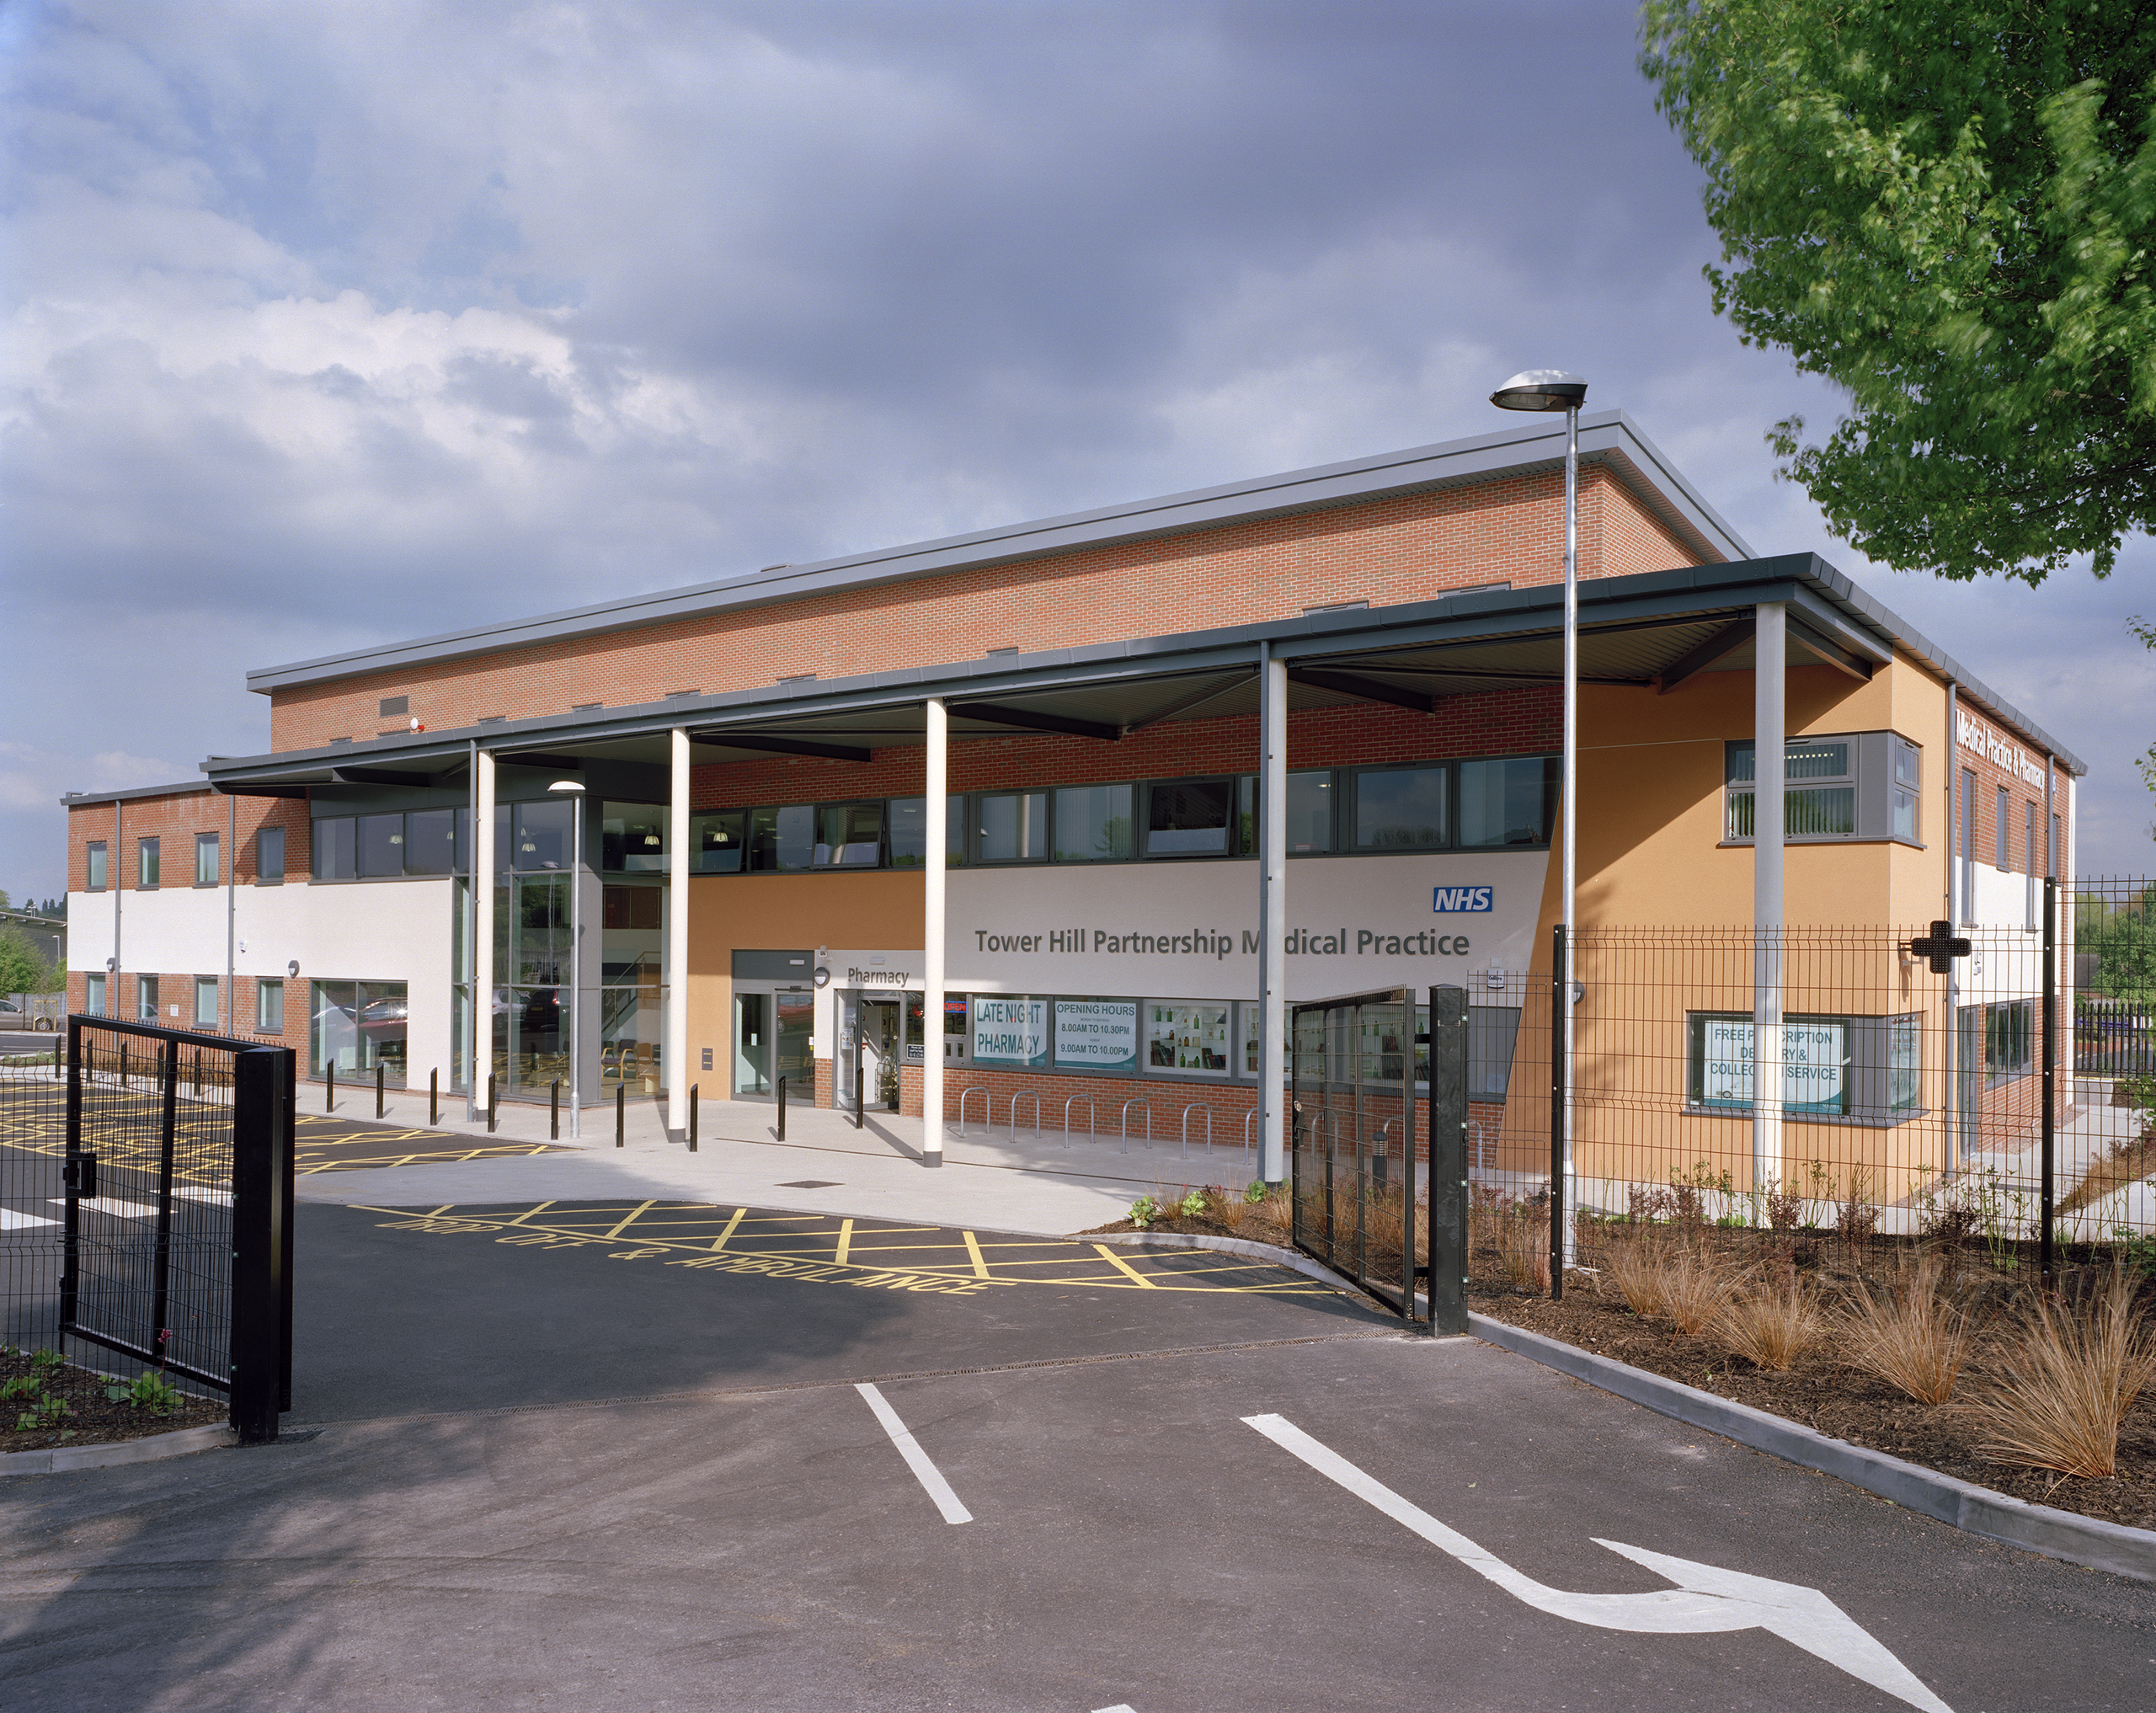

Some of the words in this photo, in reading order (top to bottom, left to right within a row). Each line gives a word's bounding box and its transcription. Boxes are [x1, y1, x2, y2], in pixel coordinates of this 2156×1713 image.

[1956, 708, 1986, 757] Medical
[1986, 728, 2013, 773] Practice
[2013, 746, 2019, 776] &
[2019, 750, 2045, 798] Pharmacy
[1434, 888, 1491, 910] NHS
[974, 930, 1043, 953] Tower
[1049, 928, 1086, 953] Hill
[1093, 928, 1232, 960] Partnership
[1241, 928, 1346, 955] Mdical
[1357, 928, 1470, 956] Practice
[847, 967, 910, 988] Pharmacy
[943, 1002, 966, 1011] OPEN
[976, 1002, 1003, 1022] LATE
[1006, 1003, 1041, 1023] NIGHT
[1056, 1004, 1100, 1015] OPENING
[1102, 1005, 1135, 1016] HOURS
[1061, 1023, 1087, 1033] 8.00AM
[1088, 1024, 1099, 1033] TO
[1100, 1025, 1129, 1035] 10.30PM
[1715, 1028, 1744, 1041] FREE
[1748, 1029, 1833, 1044] PRIPTION
[978, 1033, 1039, 1054] PHARMACY
[1060, 1043, 1086, 1054] 9.00AM
[1088, 1044, 1098, 1054] TO
[1099, 1046, 1129, 1056] 10.00PM
[1740, 1047, 1796, 1061] DERY
[1799, 1049, 1807, 1061] &
[1710, 1063, 1784, 1078] COLLEC
[1787, 1067, 1837, 1081] SERVICE
[374, 1219, 504, 1235] DROP
[494, 1233, 617, 1250] OFF
[607, 1247, 671, 1261] &
[663, 1254, 1017, 1295] AMBULANCE
